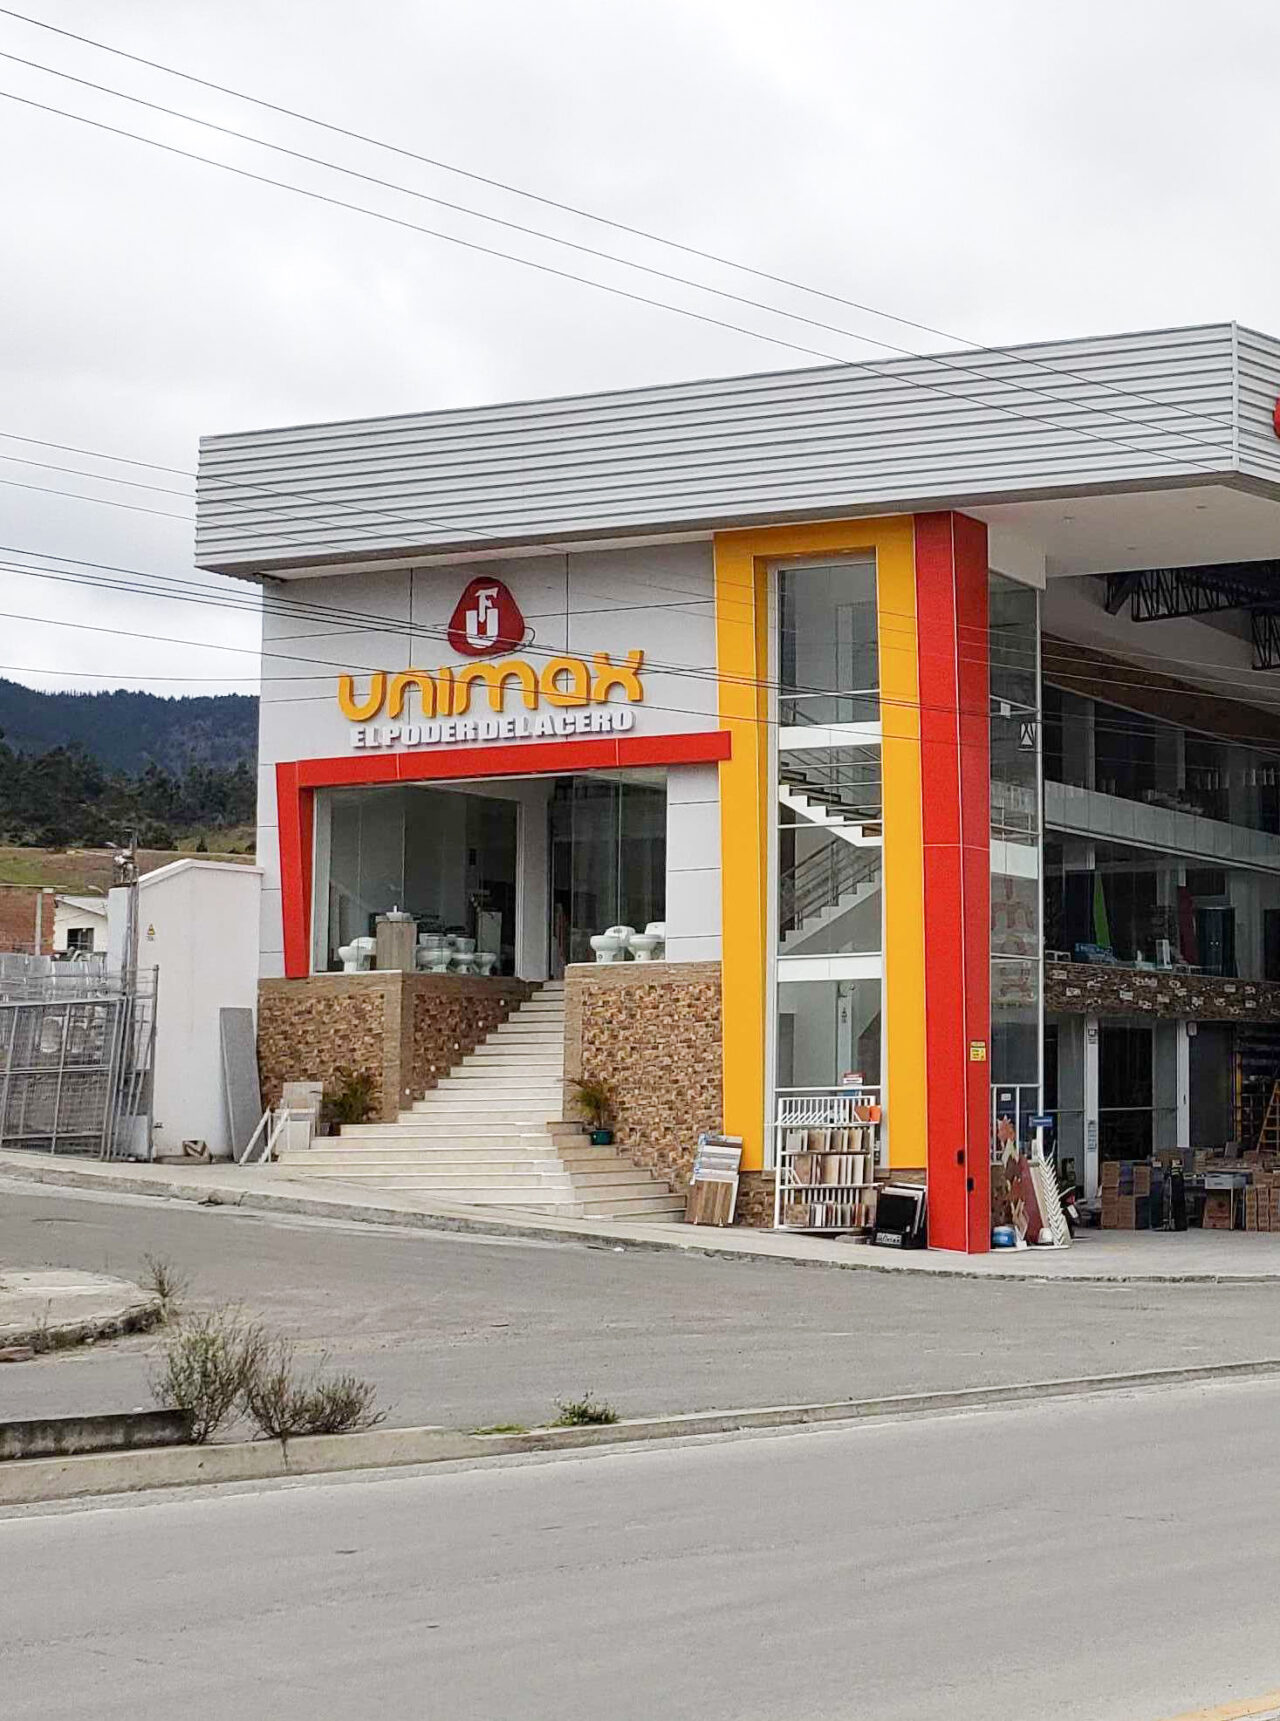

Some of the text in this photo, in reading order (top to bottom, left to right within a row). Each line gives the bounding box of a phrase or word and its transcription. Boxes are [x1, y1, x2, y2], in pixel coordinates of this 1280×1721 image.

[350, 711, 634, 748] EL PODER DEL ACERO
